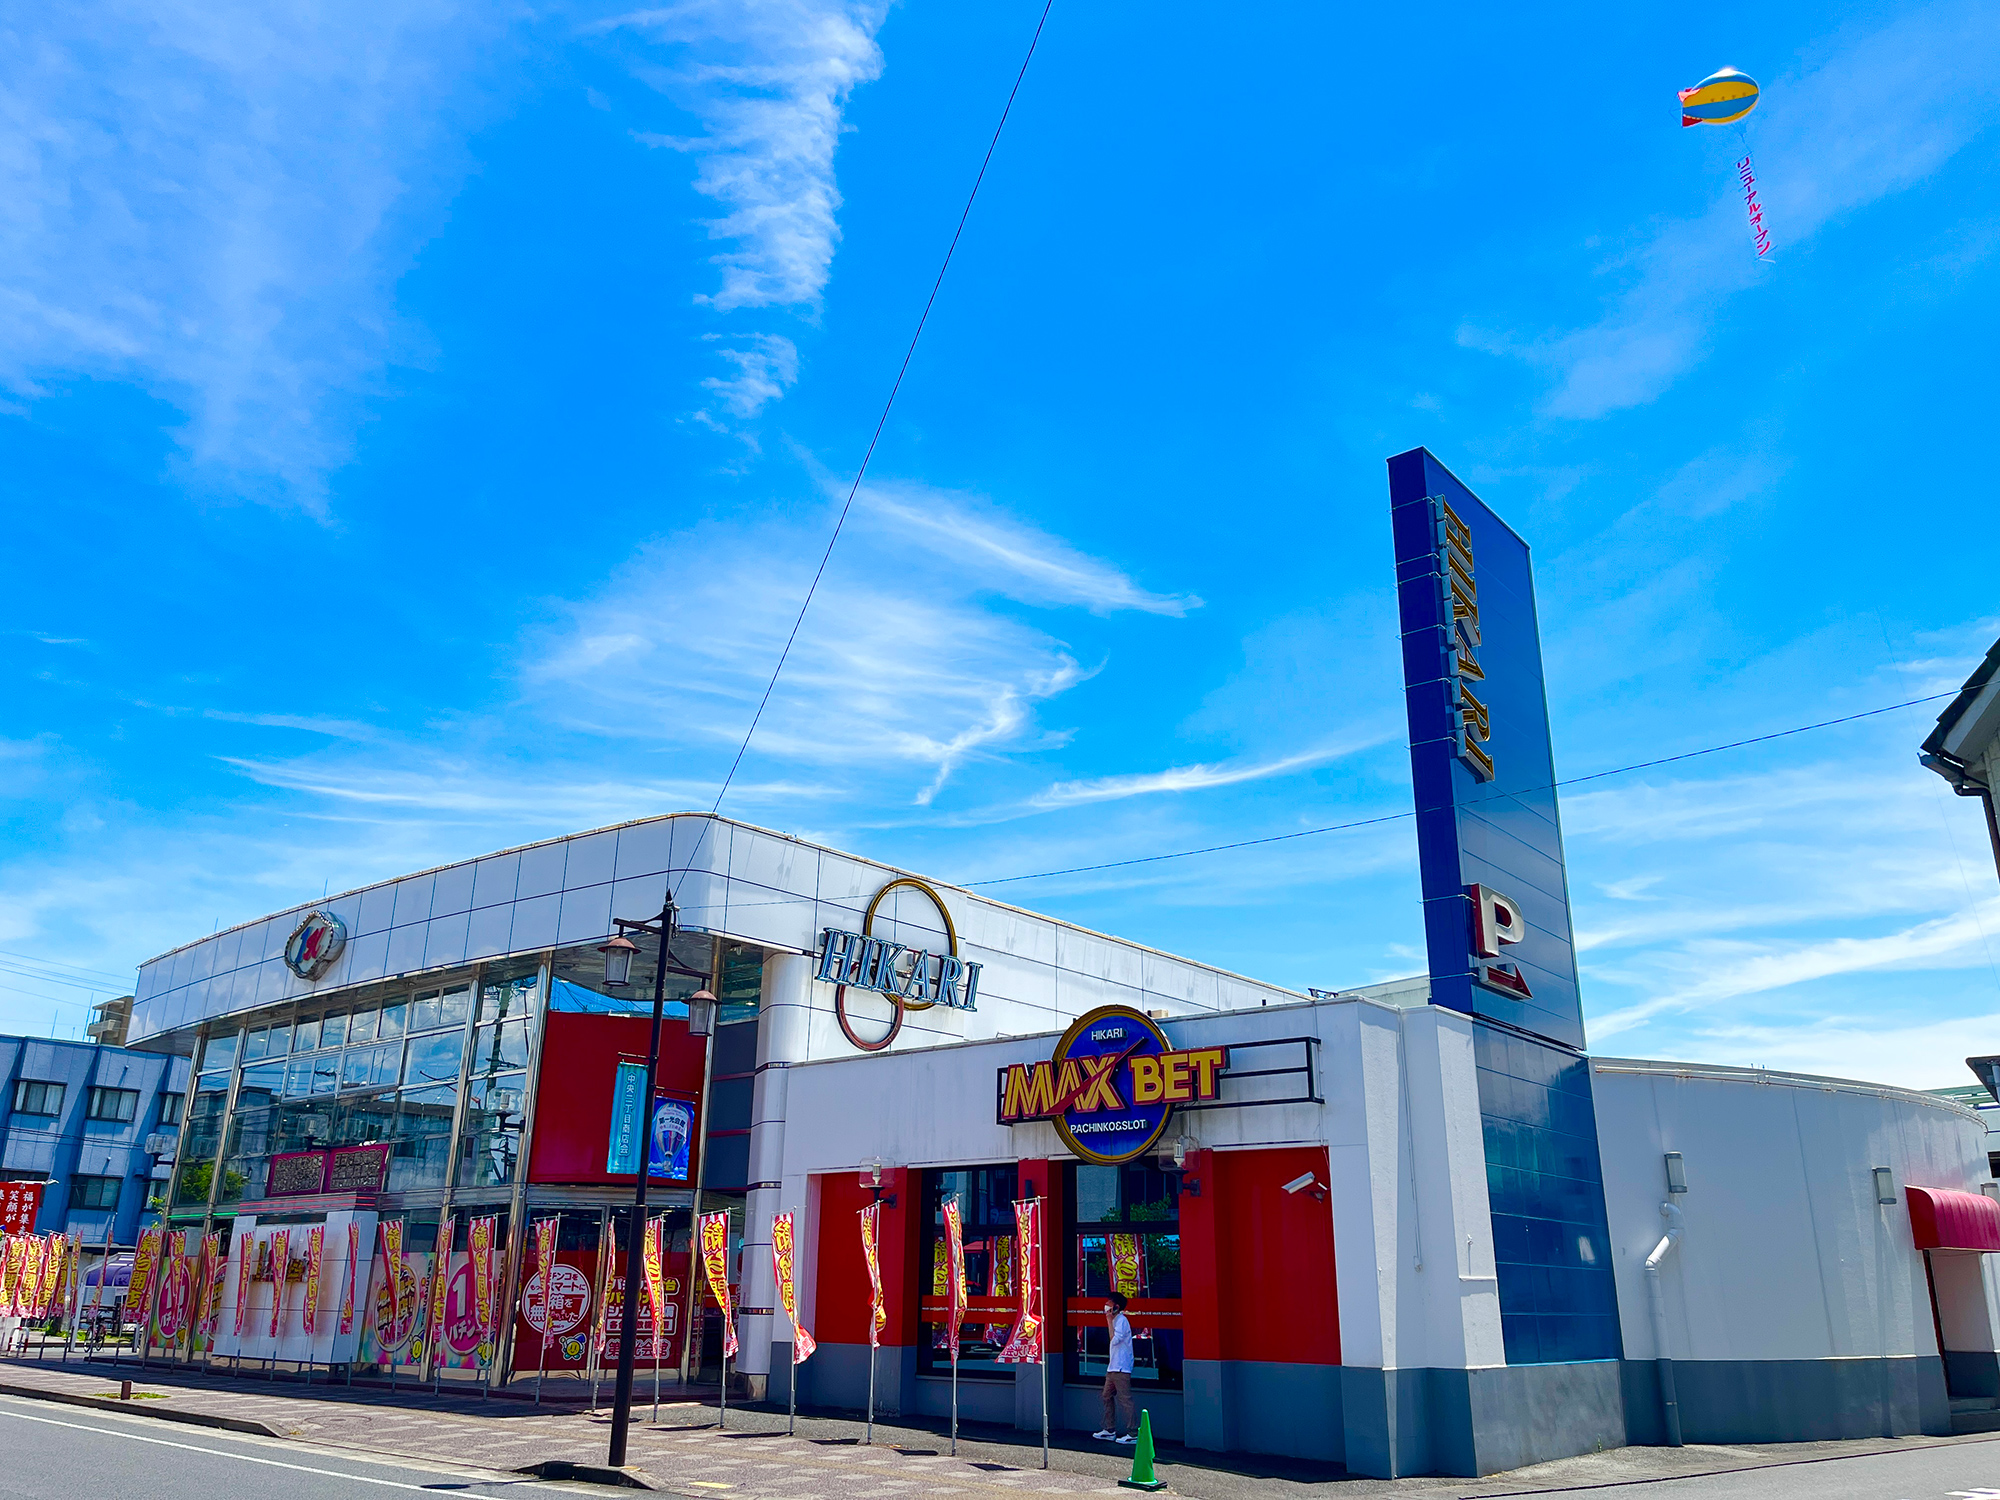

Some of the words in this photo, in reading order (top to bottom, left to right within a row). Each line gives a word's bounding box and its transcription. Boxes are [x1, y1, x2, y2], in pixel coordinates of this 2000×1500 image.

[1434, 495, 1496, 783] HIKARI
[814, 926, 984, 1013] HIKARI
[1091, 1028, 1124, 1041] HIKARI
[1001, 1051, 1126, 1120] MAX
[1128, 1045, 1227, 1106] BET
[1070, 1118, 1147, 1134] PACHINKO&SLOT
